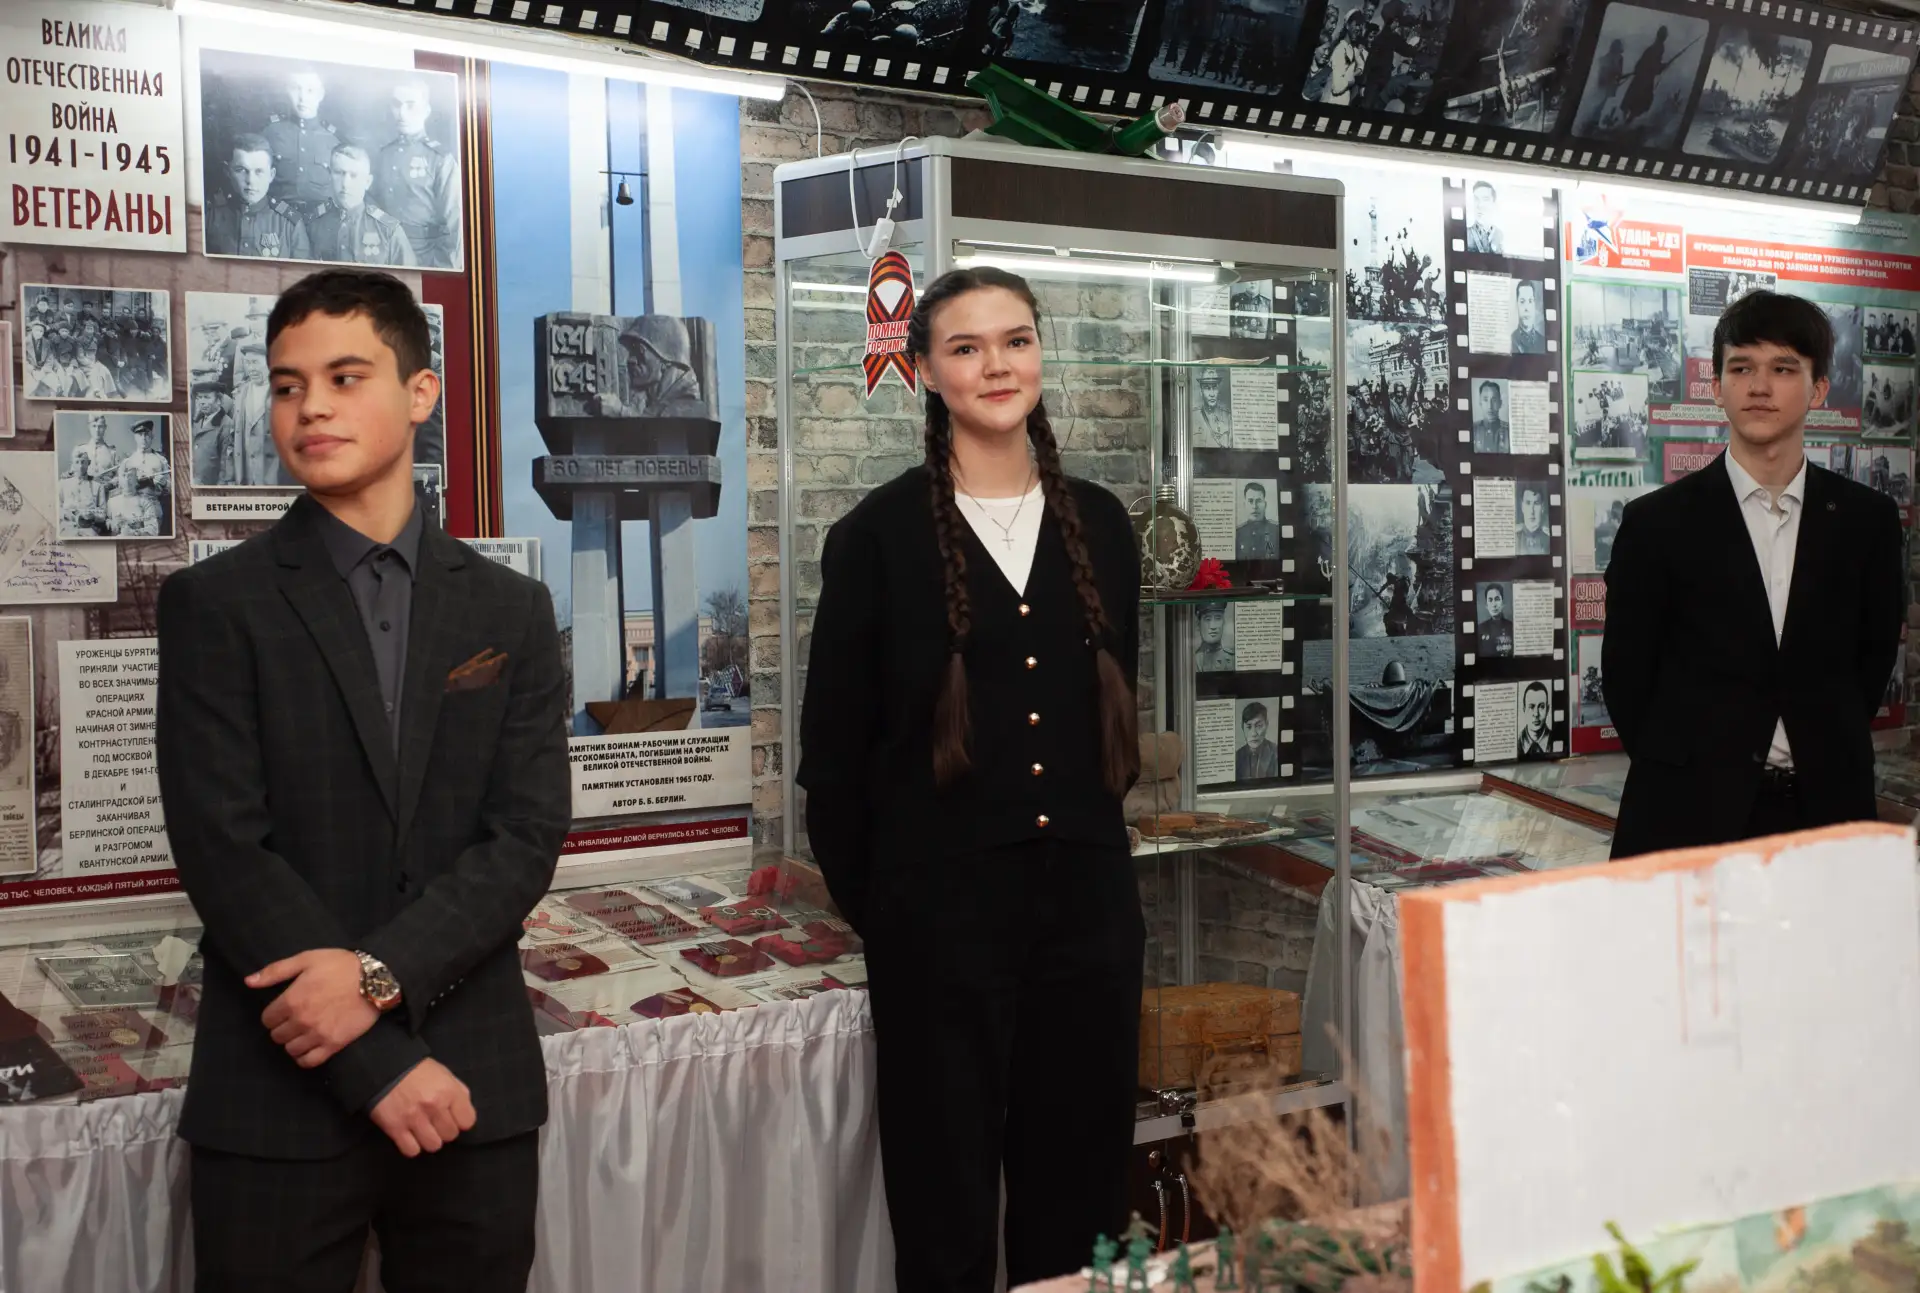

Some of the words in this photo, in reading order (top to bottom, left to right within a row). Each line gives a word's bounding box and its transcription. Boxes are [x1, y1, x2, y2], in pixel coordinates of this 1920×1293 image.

[42, 18, 127, 53] ВЕЛИКАЯ
[6, 57, 164, 97] ОТЕЧЕСТВЕННАЯ
[52, 101, 118, 134] ВОЙНА
[9, 133, 170, 175] 1941-1945
[12, 183, 172, 235] ВЕТЕРАНЫ
[1864, 258, 1883, 267] ТЫЛА
[866, 338, 906, 354] ГОРДИМС
[636, 459, 702, 477] ПОБЕДЫ
[206, 503, 253, 512] ВЕТЕРАНЫ
[255, 502, 290, 512] ВТОРОЙ
[1575, 583, 1606, 600] СУДОР
[75, 649, 122, 659] УРОЖЕНЦЫ
[79, 664, 118, 674] ПРИНЯЛИ
[122, 662, 159, 672] УЧАСТИЕ
[79, 680, 91, 689] ВО
[92, 679, 114, 688] ВСЕХ
[116, 677, 160, 687] ЗНАЧИМЫХ
[95, 693, 145, 703] ОПЕРАЦИЯХ
[85, 707, 124, 718] КРАСНОЙ
[75, 723, 115, 734] НАЧИНАЯ
[116, 723, 127, 732] ОТ
[129, 721, 157, 731] ЗИМНЕ
[569, 743, 606, 753] АМЯТНИК
[607, 738, 679, 751] ВОИНАМ-РАБОЧИМ
[680, 738, 686, 746] И
[687, 735, 730, 745] СЛУЖАЩИМ
[639, 748, 682, 758] ПОГИБШИМ
[683, 747, 694, 755] НА
[695, 744, 729, 754] ФРОНТАХ
[93, 754, 111, 763] ПОД
[112, 750, 152, 762] МОСКВОЙ
[583, 760, 619, 771] ВЕЛИКОЙ
[620, 756, 682, 769] ОТЕЧЕСТВЕННОЙ
[684, 755, 713, 764] ВОЙНЫ.
[84, 770, 90, 779] В
[91, 768, 129, 779] ДЕКАБРЕ
[120, 782, 127, 791] И
[581, 780, 625, 791] ПАМЯТНИК
[625, 776, 674, 788] УСТАНОВЛЕН
[675, 775, 692, 784] 1965
[693, 773, 715, 783] ГОДУ.
[68, 795, 145, 810] СТАЛИНГРАДСКОЙ
[146, 795, 162, 805] БИТ
[612, 798, 637, 808] АВТОР
[638, 798, 646, 806] Б.
[647, 796, 654, 805] Б.
[655, 794, 687, 805] БЕРЛИН.
[96, 810, 150, 823] ЗАКАНЧИВАЯ
[69, 825, 125, 840] БЕРЛИНСКОЙ
[126, 824, 166, 835] ОПЕРАЦИ
[578, 836, 622, 847] ИНВАЛИДАМИ
[622, 833, 647, 844] ДОМОЙ
[647, 830, 685, 841] ВЕРНУЛИСЬ
[695, 827, 711, 837] ТЫС.
[711, 825, 741, 835] ЧЕЛОВЕК.
[94, 844, 101, 853] И
[102, 840, 153, 852] РАЗГРОМОМ
[79, 854, 138, 869] КВАНТУНСКОЙ
[10, 890, 32, 899] ТЫС.
[33, 886, 75, 897] ЧЕЛОВЕК,
[76, 881, 113, 893] КАЖДЫЙ
[115, 879, 144, 889] ПЯТЫЙ
[146, 877, 180, 887] ЖИТЕЛЬ
